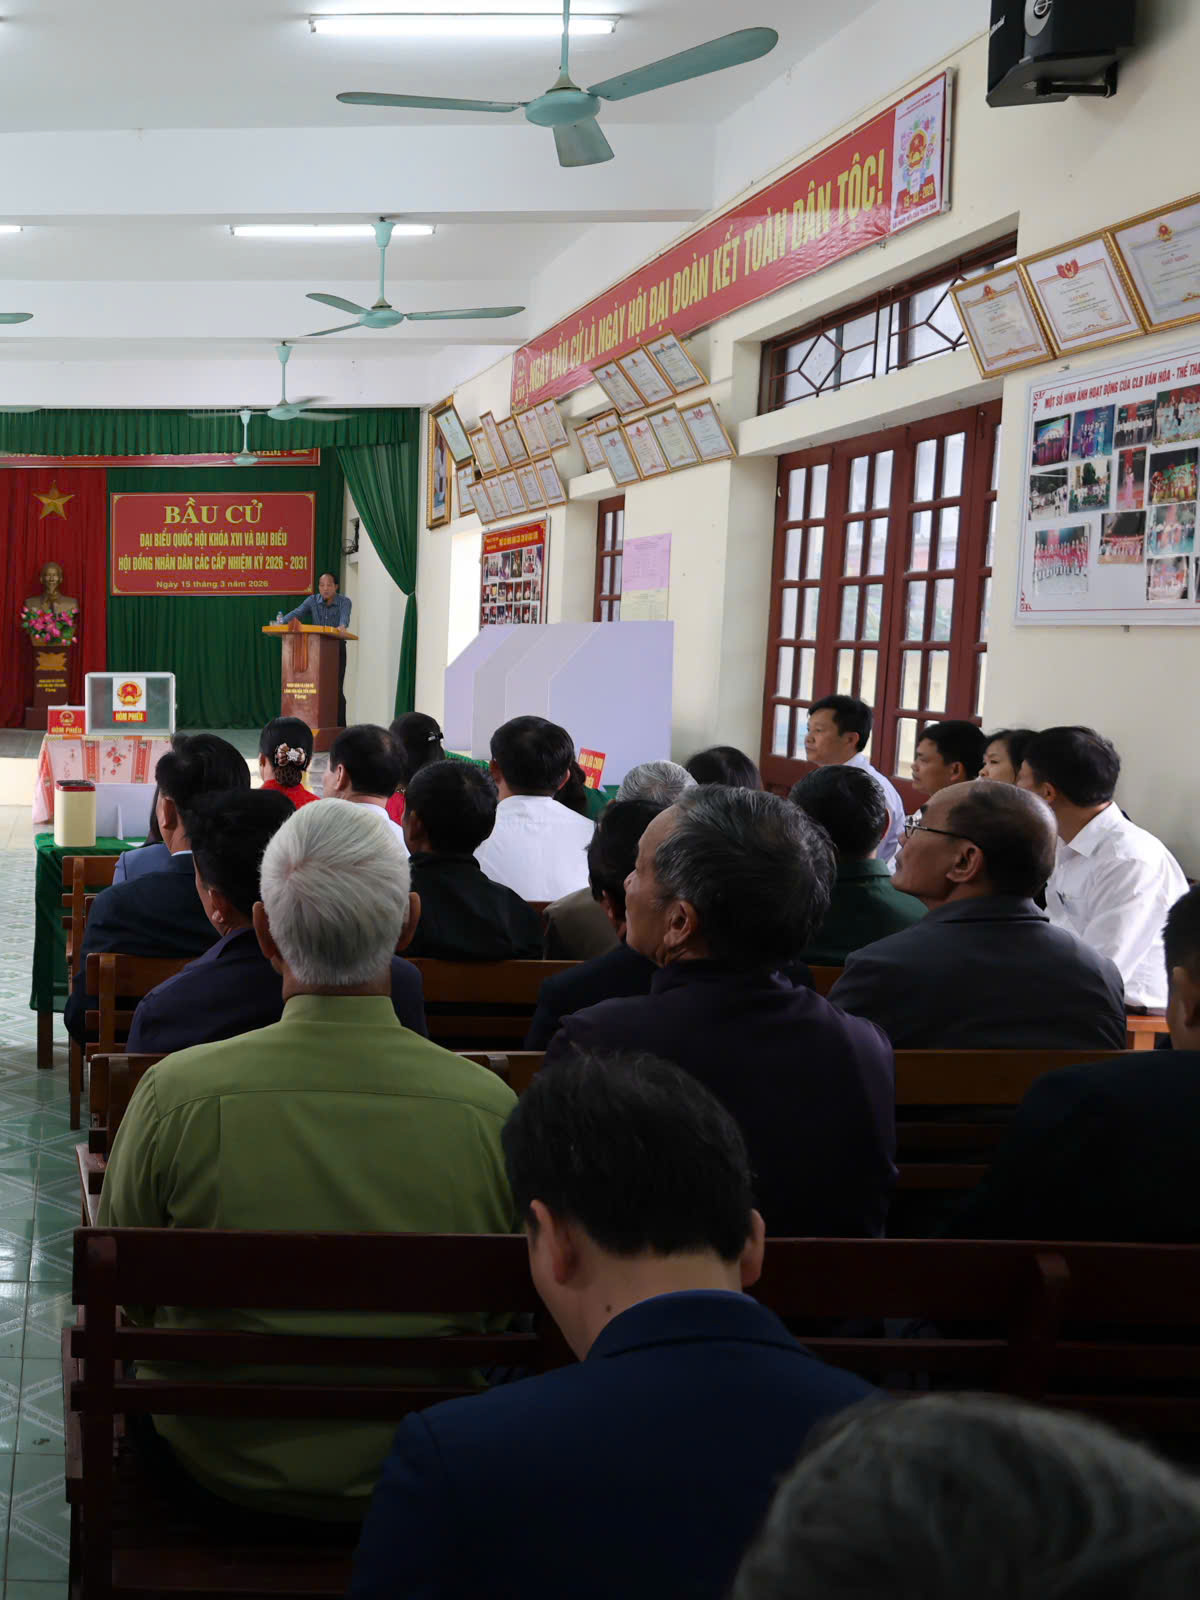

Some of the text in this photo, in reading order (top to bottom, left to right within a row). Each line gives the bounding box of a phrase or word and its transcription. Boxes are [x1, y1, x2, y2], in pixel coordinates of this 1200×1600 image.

[529, 349, 550, 393] NGÀY
[584, 316, 596, 363] LÀ
[598, 302, 626, 355] NGÀY
[627, 287, 647, 343] HỘI
[649, 278, 670, 331] ĐẠI
[672, 252, 710, 314] ĐOÀN
[712, 224, 741, 294] KẾT
[744, 207, 787, 276] TOÀN
[792, 180, 832, 251] DÂN
[837, 148, 885, 233] TỘC!
[1045, 396, 1055, 408] MỘT
[1056, 391, 1063, 406] SỐ
[1089, 385, 1103, 400] HOẠT
[1103, 381, 1118, 397] ĐỘNG
[1119, 376, 1131, 391] CỦA
[1132, 375, 1144, 388] CLB
[164, 497, 263, 524] BẦU CỬ
[140, 527, 288, 550] ĐẠI BIỂU QUỐC HỘI KHÓA XVI VÀ ĐẠI BIỂU
[118, 554, 131, 574] HỘI
[132, 552, 153, 570] ĐỒNG
[154, 553, 176, 570] NHÂN
[177, 553, 193, 570] DÂN
[194, 553, 210, 570] CÁC
[211, 552, 226, 570] CẤP
[228, 553, 252, 573] NHIỆM
[265, 555, 284, 570] 2026
[290, 556, 308, 570] 2031
[156, 580, 178, 590] Ngày
[193, 580, 218, 589] tháng
[227, 580, 246, 588] năm
[249, 580, 269, 588] 2026
